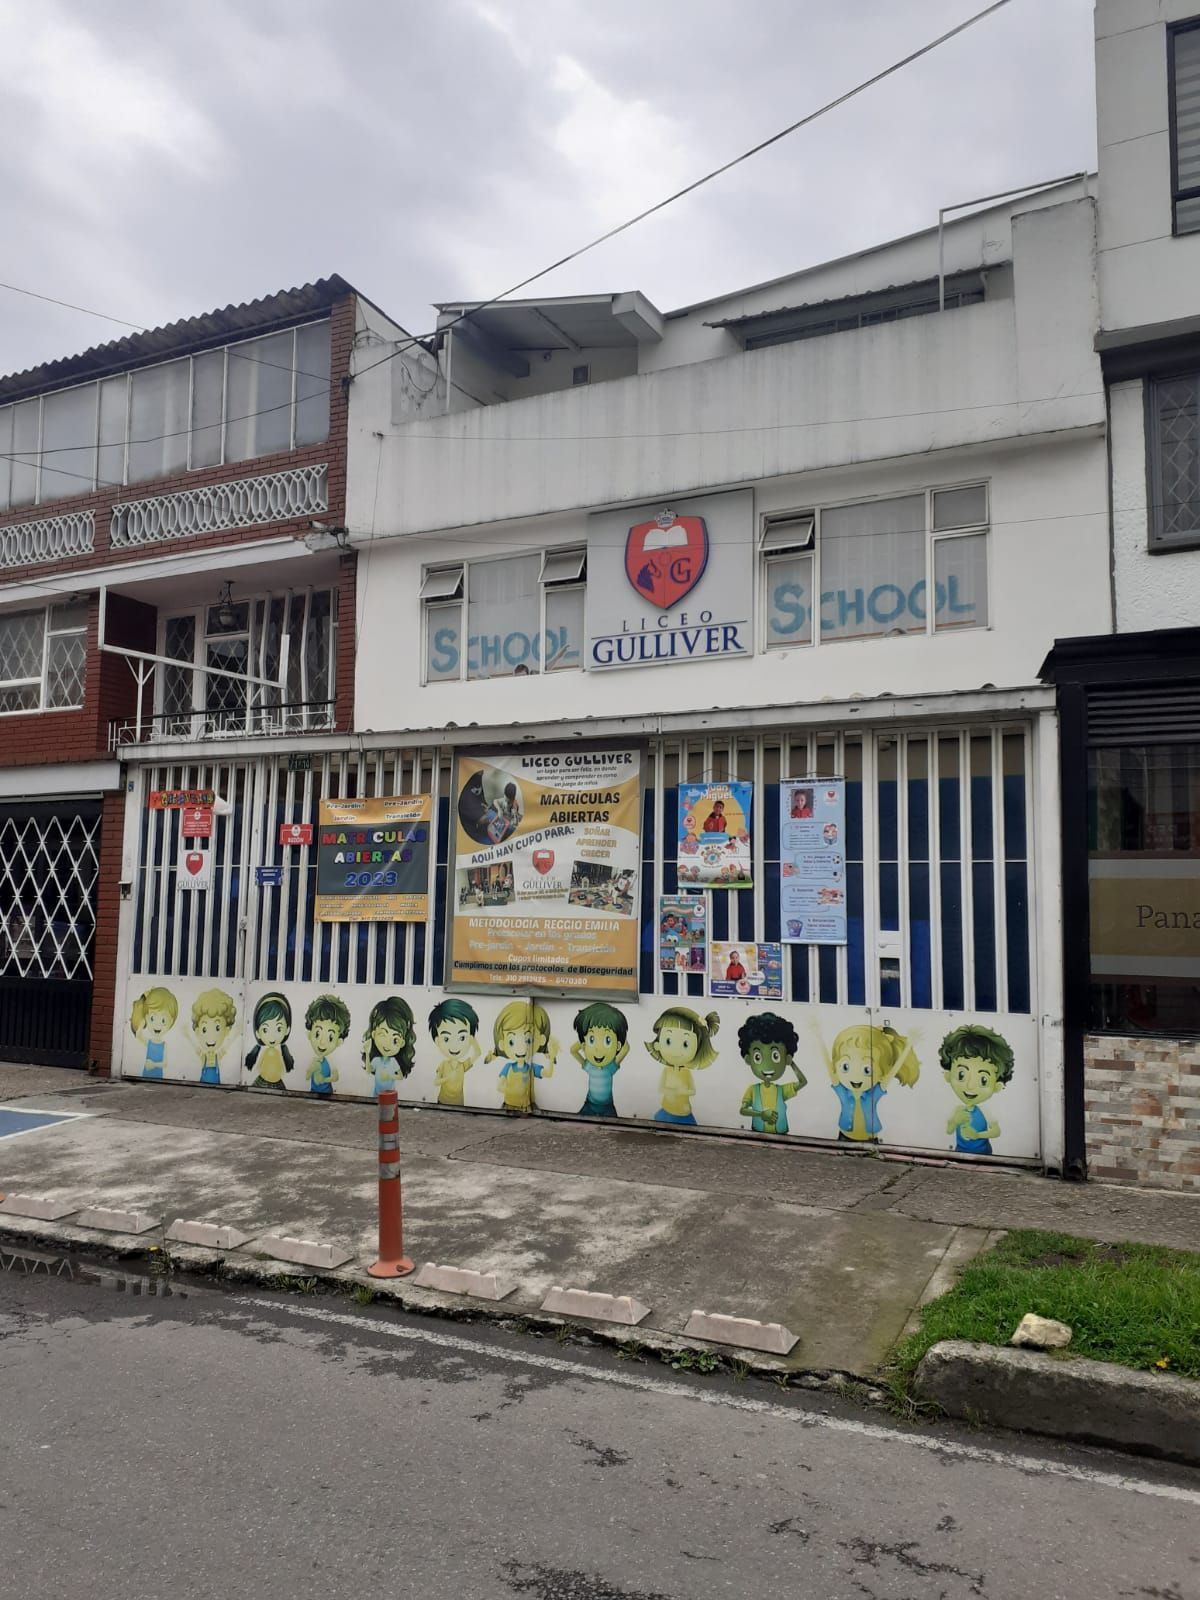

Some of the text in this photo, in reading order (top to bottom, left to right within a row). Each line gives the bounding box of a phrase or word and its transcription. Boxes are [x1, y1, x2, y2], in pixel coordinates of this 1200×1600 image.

[770, 575, 977, 636] SCHOOL
[622, 610, 713, 633] LICEO
[431, 626, 580, 673] SCHOOL
[592, 625, 744, 664] GULLIVER
[564, 753, 632, 767] GULLIVER
[540, 790, 620, 806] MATRÍCULAS
[550, 811, 609, 823] ABIERTAS
[321, 828, 427, 846] MATRÍCULAS
[496, 844, 514, 860] HAY
[516, 834, 543, 851] CUPO
[544, 825, 575, 841] PARA:
[575, 839, 617, 848] APRENDER
[334, 849, 413, 864] ABIERTAS
[580, 850, 611, 859] CRECER
[343, 870, 398, 888] 2023
[522, 880, 562, 889] GULLIVER
[544, 918, 582, 930] REGGIO
[585, 920, 620, 931] EMILIA
[508, 953, 569, 964] Cupos limitados
[454, 960, 633, 977] Cumplimos con los protocolos de Bioseguridad
